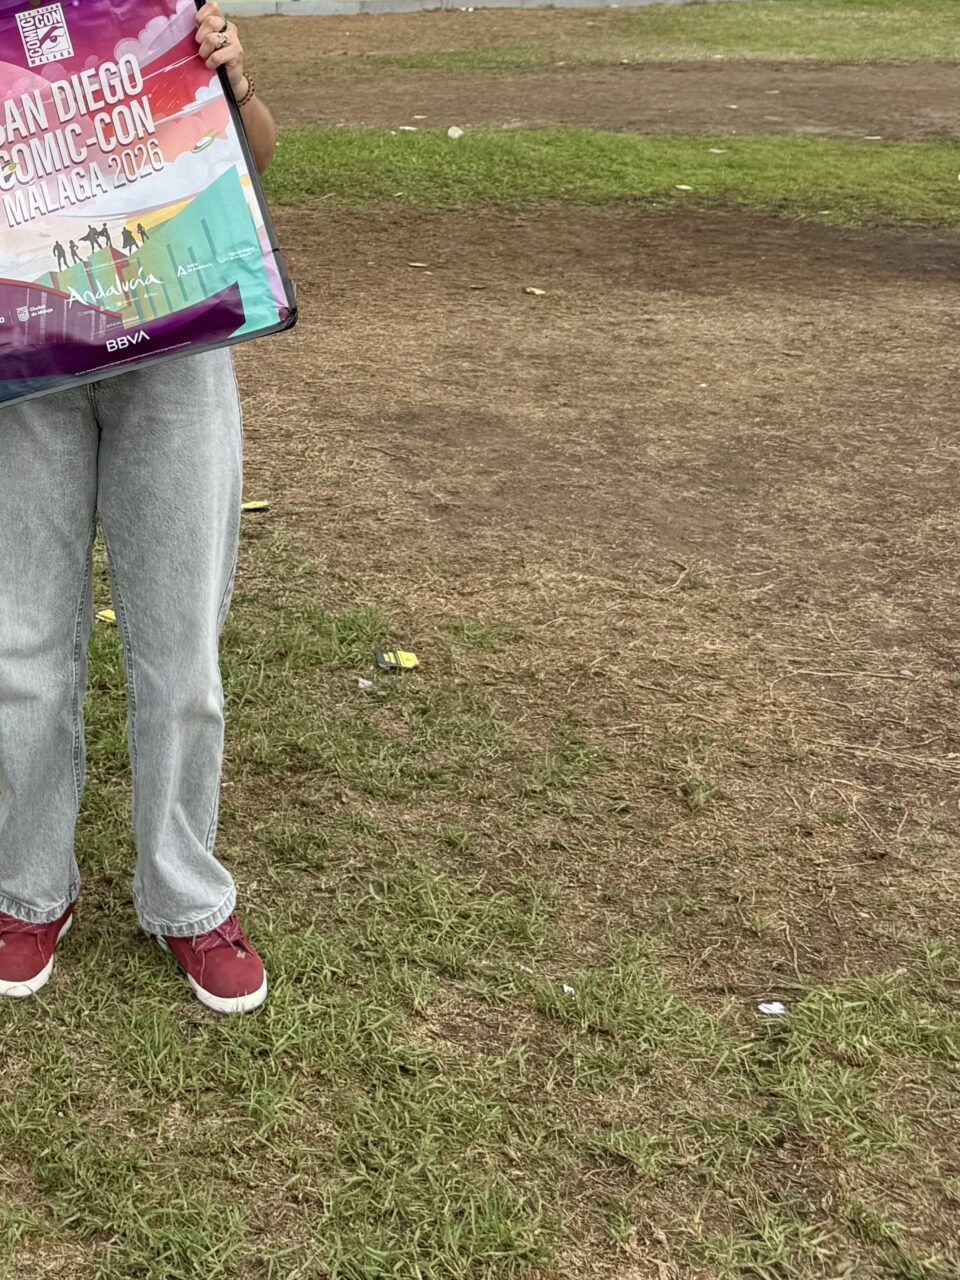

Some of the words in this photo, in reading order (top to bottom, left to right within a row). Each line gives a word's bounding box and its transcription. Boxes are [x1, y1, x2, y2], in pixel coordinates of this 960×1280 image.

[20, 17, 43, 58] COMIC
[34, 10, 62, 28] CON
[50, 53, 144, 124] DIEGO
[108, 137, 165, 189] 2026
[65, 266, 164, 309] Andalucía
[105, 329, 150, 352] BBVA
